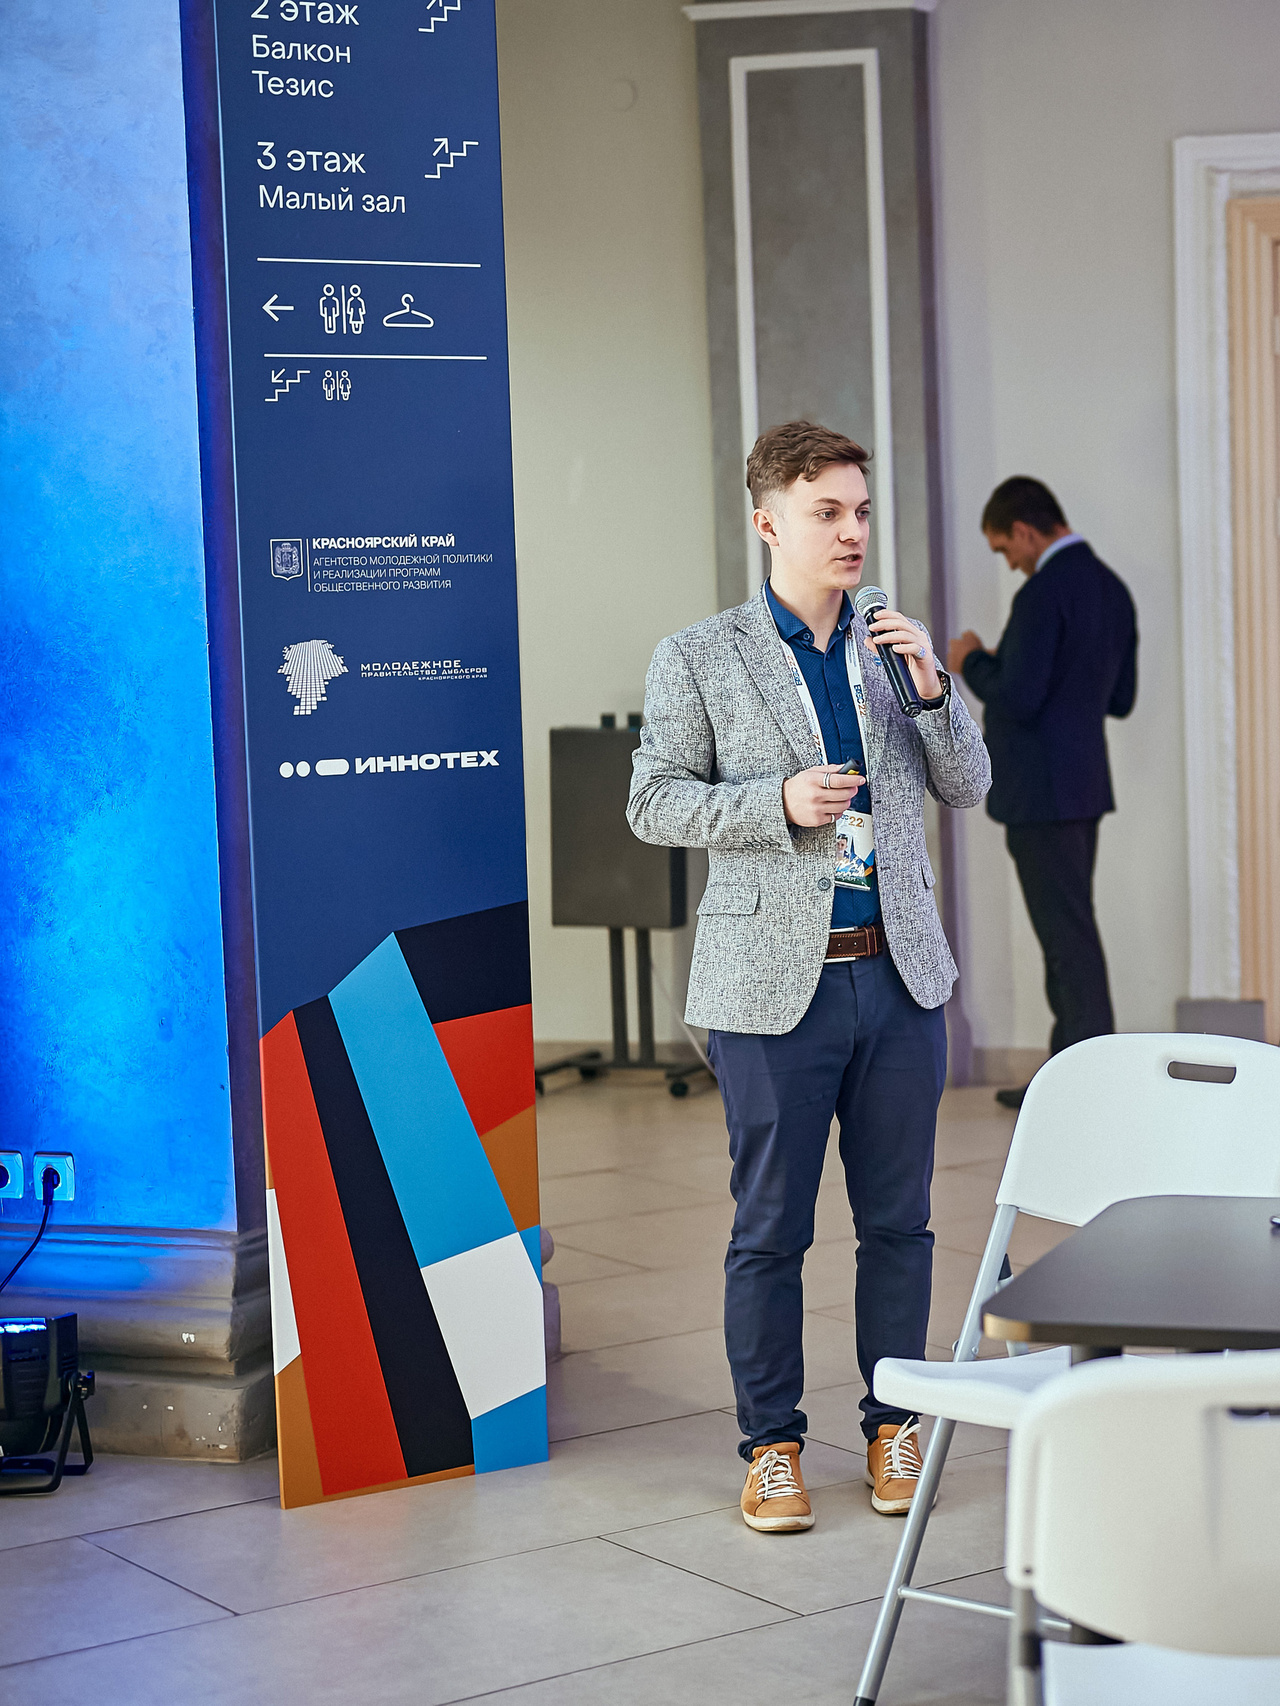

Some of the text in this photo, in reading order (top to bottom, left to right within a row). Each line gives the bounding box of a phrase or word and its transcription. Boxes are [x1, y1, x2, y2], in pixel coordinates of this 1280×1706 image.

[251, 0, 360, 26] 2 этаж
[252, 34, 351, 64] Балкон
[251, 70, 334, 98] Тезис
[256, 141, 366, 174] 3 этаж
[259, 184, 406, 214] Малый зал
[312, 533, 455, 550] КРАСНОЯРСКИЙ КРАЙ
[313, 553, 493, 567] АГЕНТСТВО МОЛОДЕЖНОЙ ПОЛИТИКИ
[313, 567, 441, 579] И РЕАЛИЗАЦИИ ПРОГРАММ
[313, 579, 452, 592] ОБЩЕСТВЕННОГО РАЗВИТИЯ
[360, 659, 461, 672] МОЛОДЕЖНОЕ
[361, 667, 488, 678] ПРАВИТЕЛЬСТВО ДУБЛЕРОВ
[355, 749, 500, 774] ИННОТЕХ
